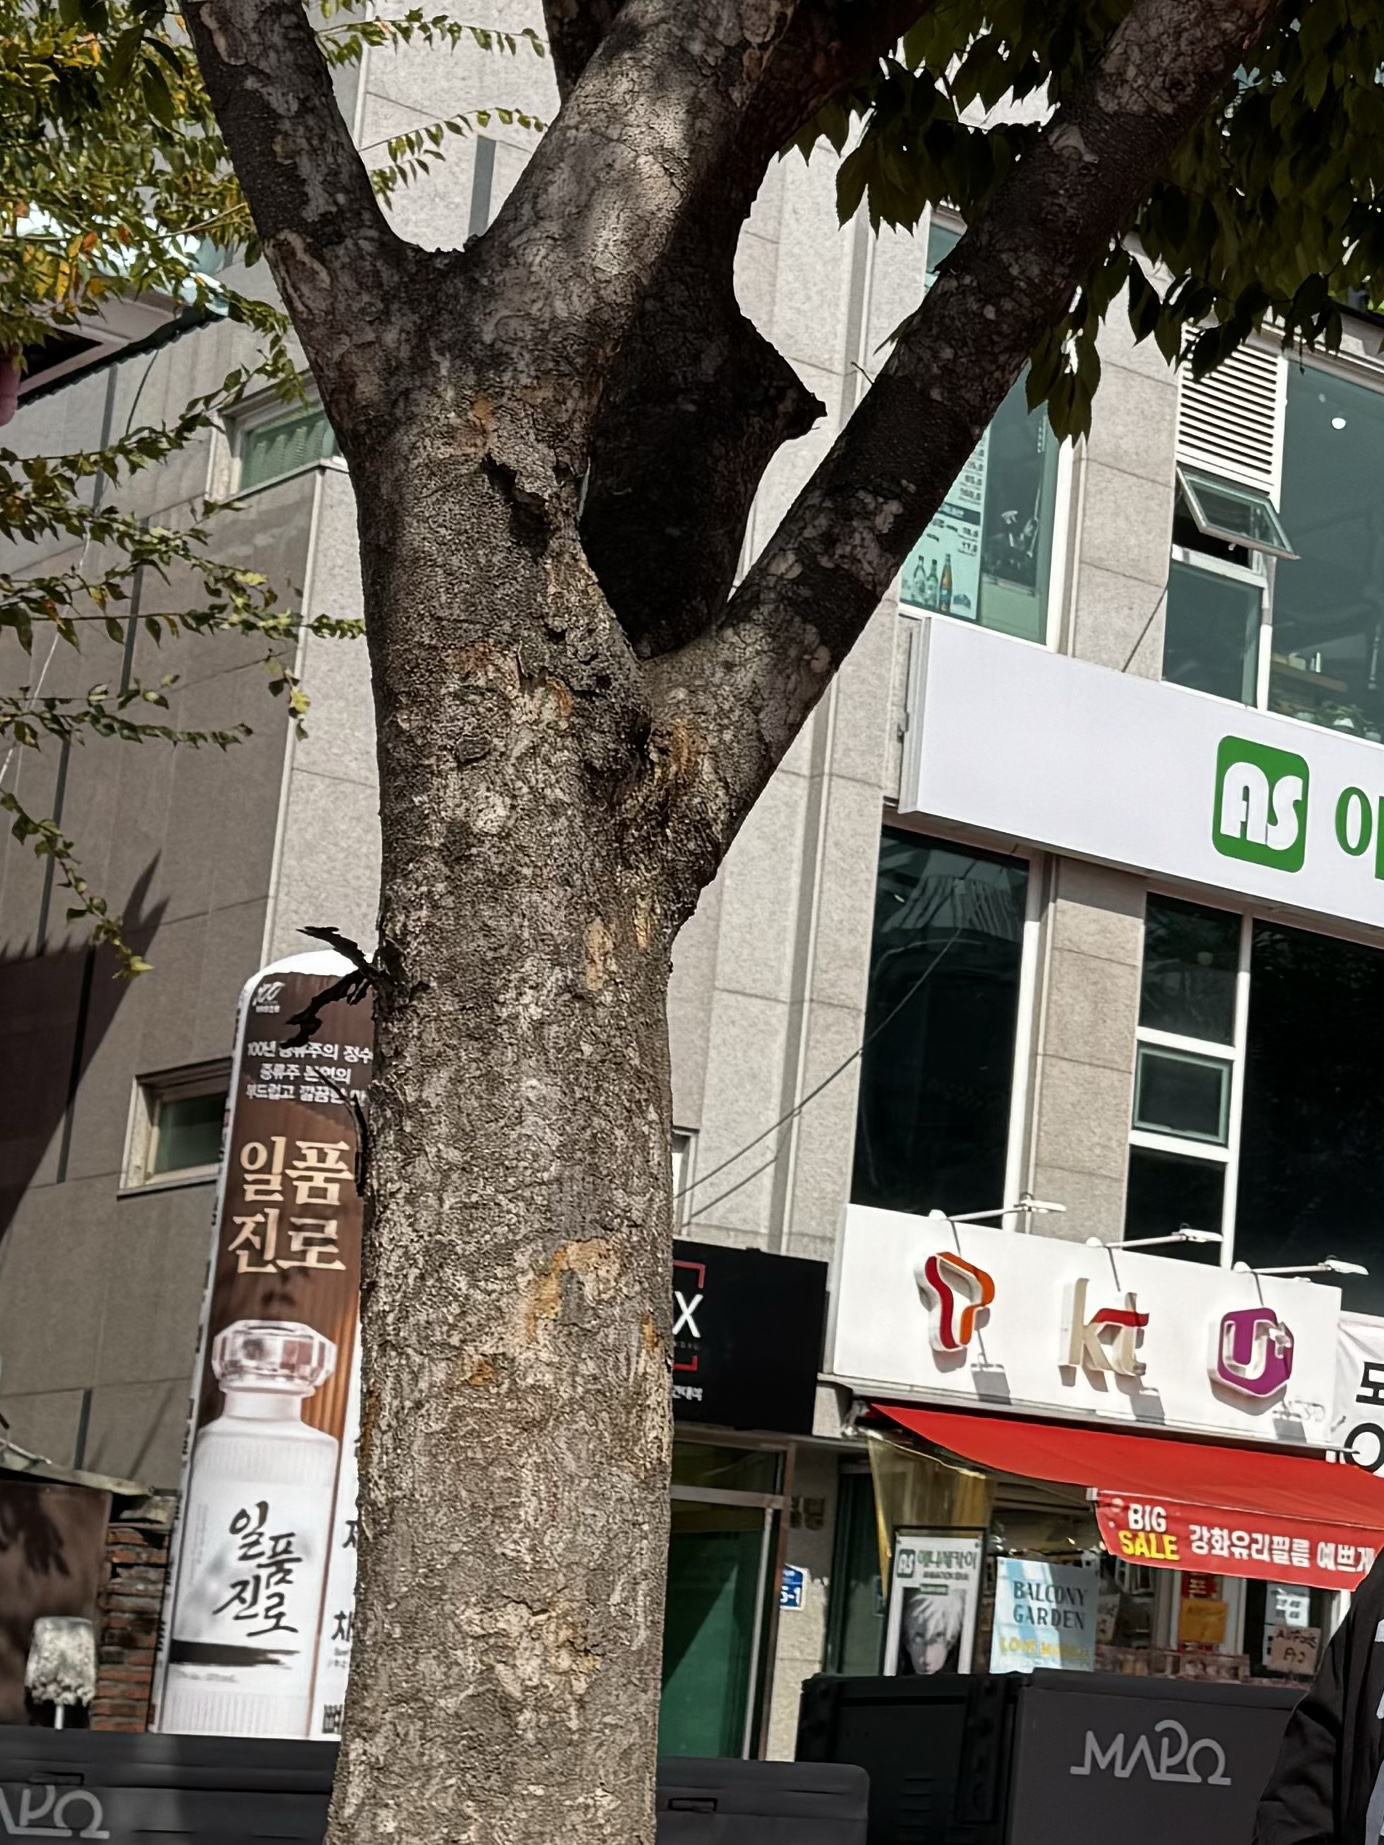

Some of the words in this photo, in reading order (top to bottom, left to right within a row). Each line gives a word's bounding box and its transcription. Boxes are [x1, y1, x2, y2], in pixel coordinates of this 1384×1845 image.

[1221, 761, 1303, 851] AS
[247, 1040, 276, 1057] 100년
[240, 1136, 355, 1206] 일품
[228, 1208, 347, 1274] 진로
[1128, 1503, 1167, 1532] BIG
[229, 1500, 303, 1590] 일품
[1118, 1529, 1180, 1561] SALE
[1189, 1524, 1311, 1568] 강화유리필름
[212, 1574, 299, 1638] 진로
[1013, 1580, 1087, 1606] BALCONY
[1013, 1604, 1085, 1630] GARDEN
